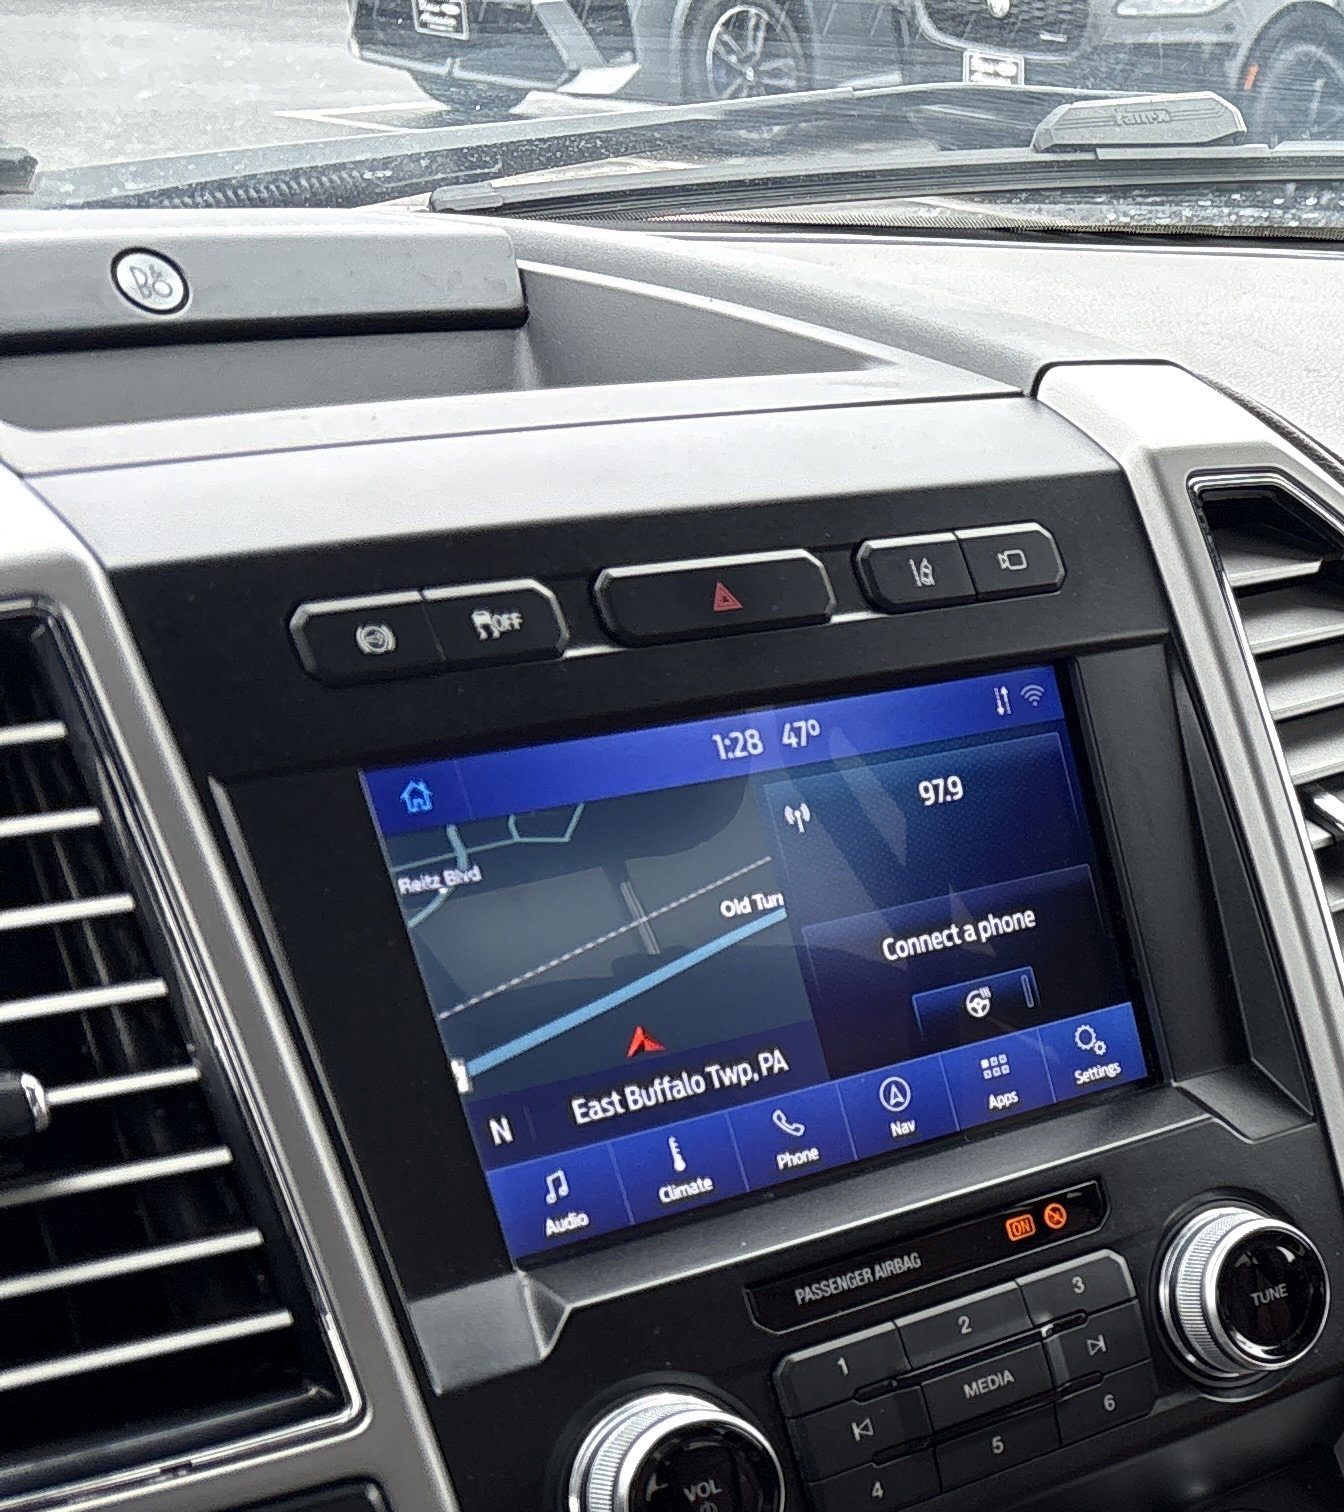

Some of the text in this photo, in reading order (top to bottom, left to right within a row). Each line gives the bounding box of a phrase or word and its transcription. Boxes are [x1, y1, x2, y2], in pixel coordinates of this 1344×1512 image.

[493, 612, 523, 632] OFF
[711, 729, 764, 761] 1:28
[918, 774, 964, 806] 97.9
[443, 865, 482, 886] Blvd
[720, 896, 752, 917] Old
[882, 909, 1037, 961] Connect a phone
[1074, 1060, 1122, 1085] Settings
[571, 1091, 626, 1125] East
[625, 1073, 706, 1113] Buffalo
[758, 1048, 789, 1075] PA
[988, 1090, 1019, 1110] Apps
[489, 1116, 513, 1145] N
[890, 1119, 915, 1137] Nav
[776, 1146, 819, 1170] Phone
[659, 1177, 713, 1203] Climate
[545, 1211, 590, 1236] Audio
[1011, 1219, 1031, 1236] ON
[795, 1252, 922, 1305] PASSENGER AIRBAG
[1072, 1276, 1086, 1293] 3
[1250, 1283, 1289, 1306] TUNE
[958, 1316, 972, 1334] 2
[837, 1357, 849, 1375] 1
[963, 1369, 1015, 1399] MEDIA
[1104, 1394, 1116, 1411] 6
[991, 1436, 1004, 1454] 5
[683, 1479, 722, 1503] VOL
[871, 1481, 884, 1499] 4
